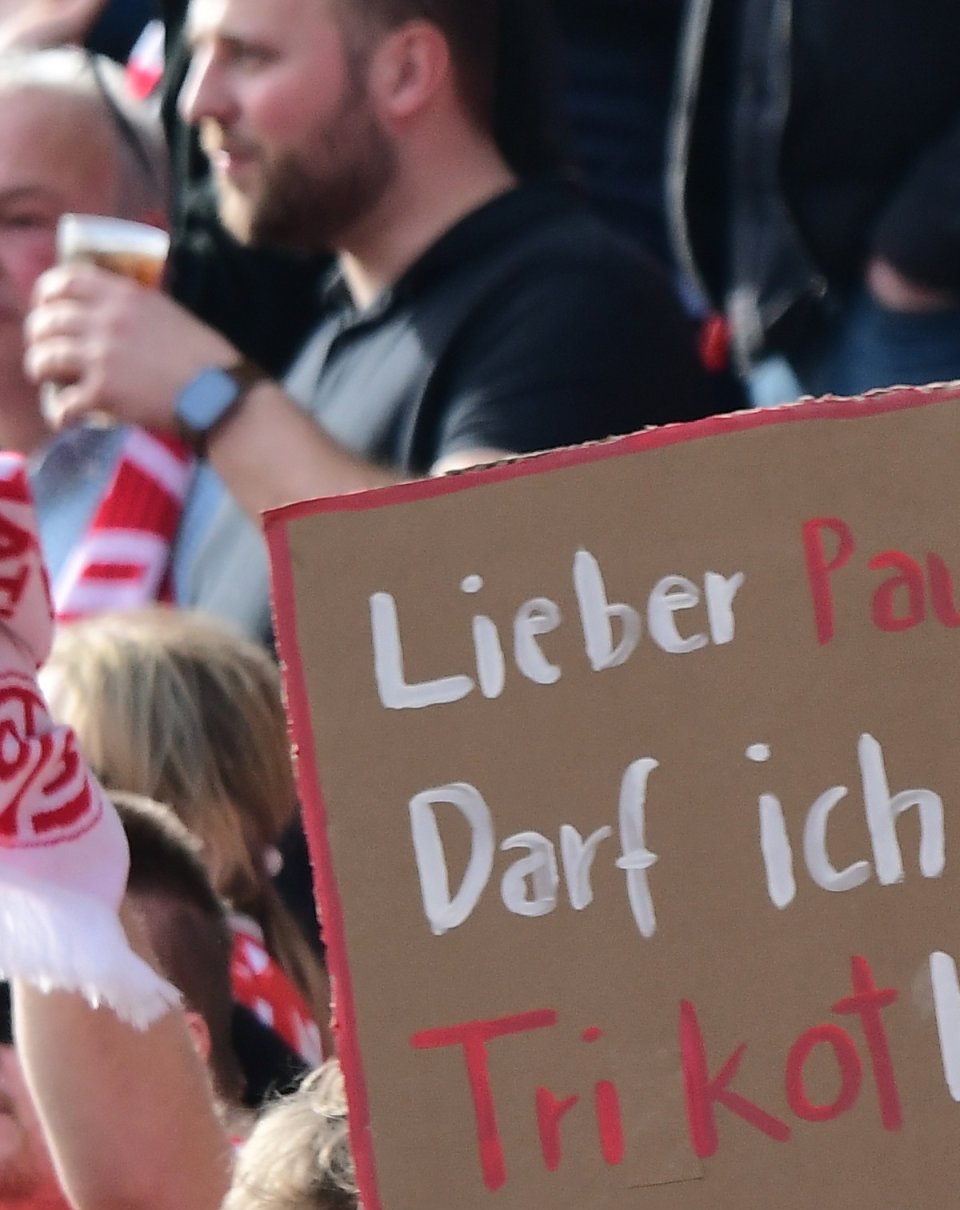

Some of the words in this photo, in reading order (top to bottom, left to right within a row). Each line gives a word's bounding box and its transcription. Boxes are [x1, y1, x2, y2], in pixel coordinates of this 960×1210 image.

[368, 546, 745, 710] Lieber
[408, 757, 660, 938] Darf
[745, 732, 945, 910] ich
